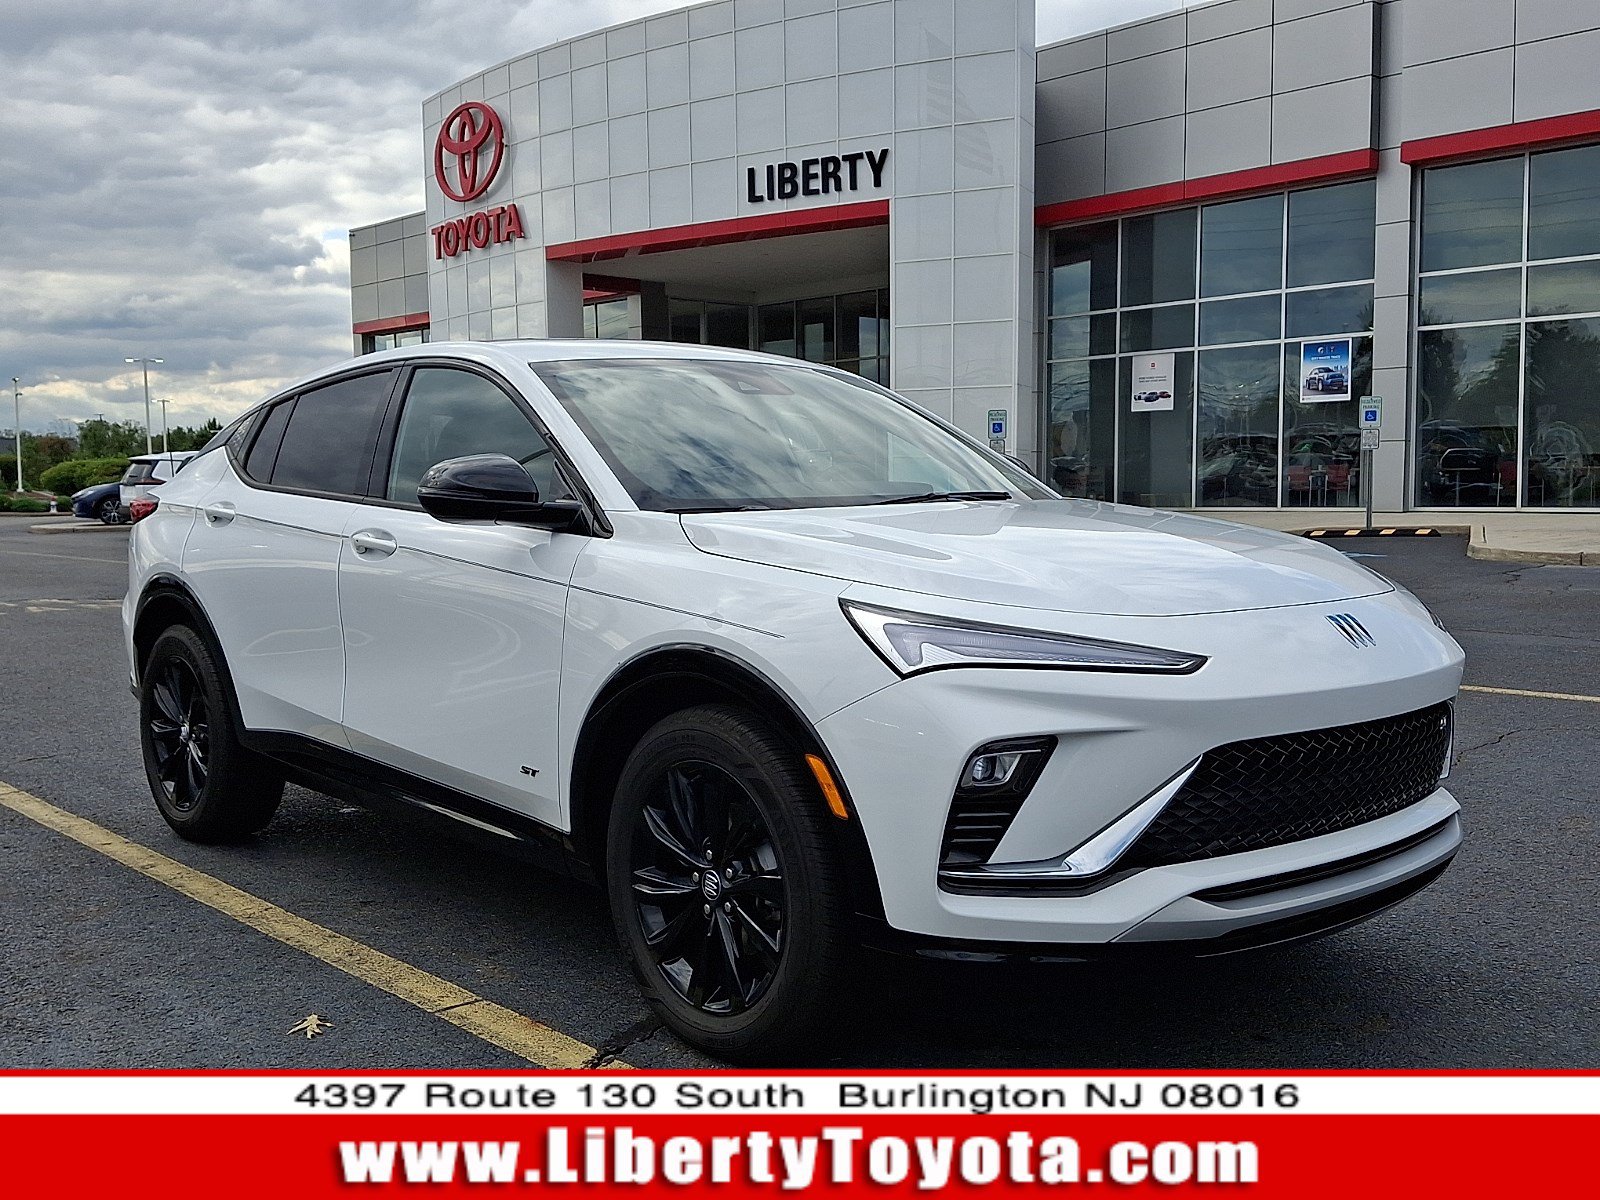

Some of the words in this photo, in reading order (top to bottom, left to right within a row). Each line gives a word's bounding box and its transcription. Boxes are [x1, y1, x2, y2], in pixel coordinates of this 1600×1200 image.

[747, 148, 890, 203] LIBERTY
[431, 203, 525, 260] TOYOTA
[519, 765, 540, 778] ST
